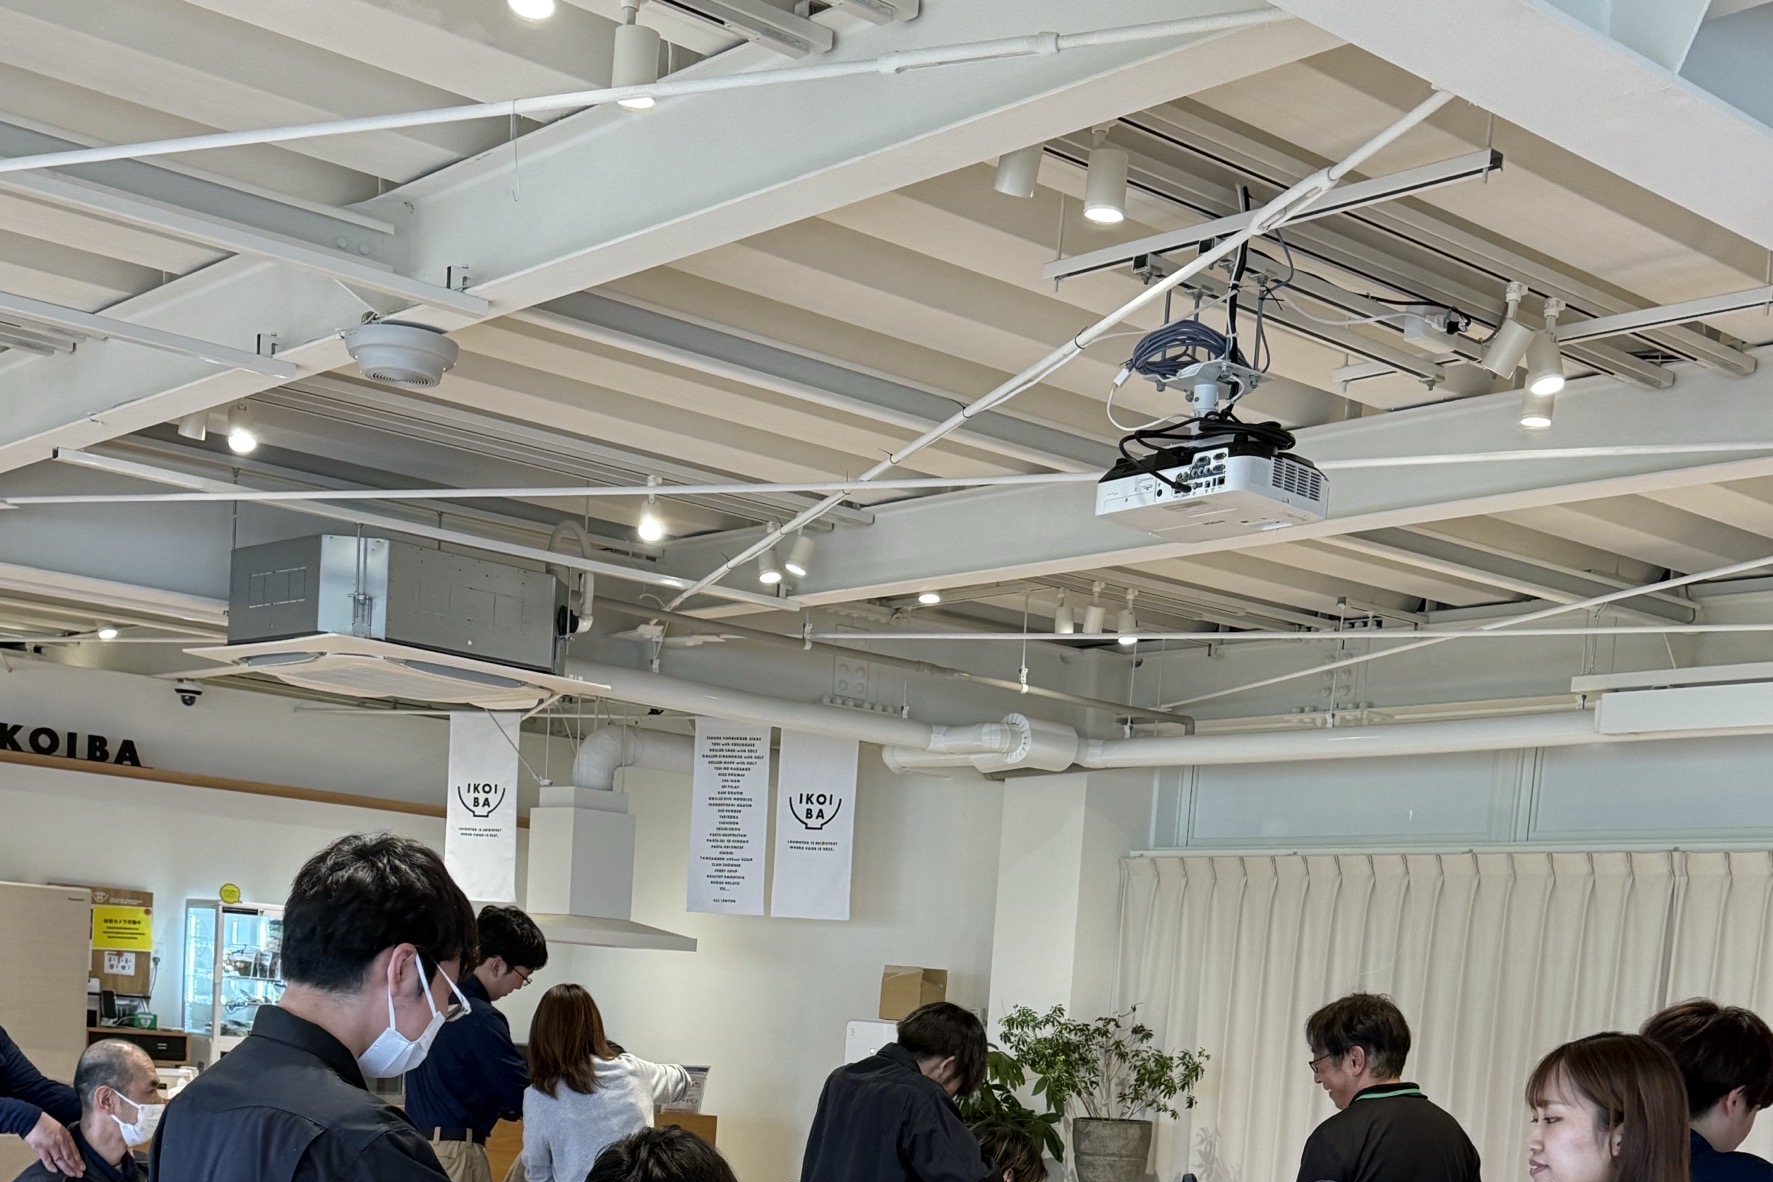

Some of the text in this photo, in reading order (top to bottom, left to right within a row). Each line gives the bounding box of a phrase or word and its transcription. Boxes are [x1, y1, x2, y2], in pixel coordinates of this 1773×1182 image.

[467, 783, 497, 794] IKOI
[473, 797, 490, 808] BA
[799, 793, 833, 805] IKOI
[805, 808, 825, 819] BA
